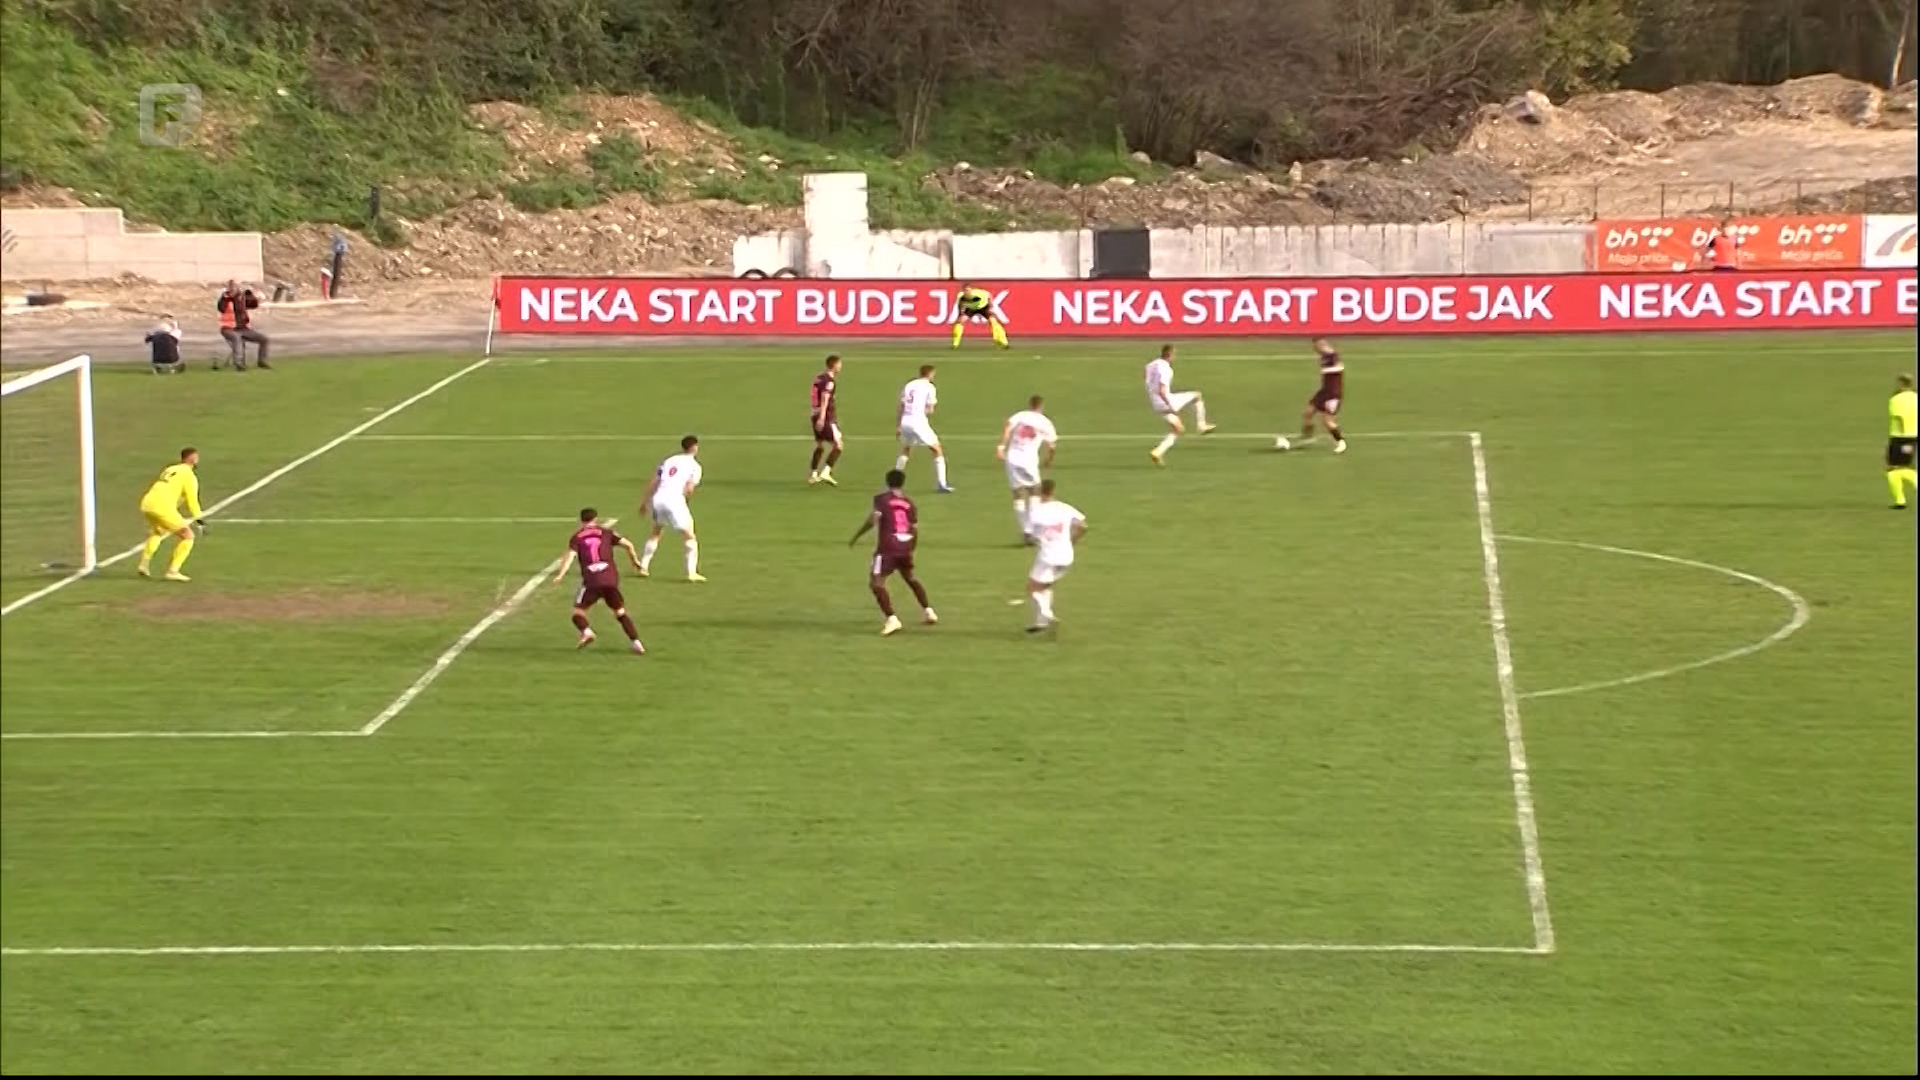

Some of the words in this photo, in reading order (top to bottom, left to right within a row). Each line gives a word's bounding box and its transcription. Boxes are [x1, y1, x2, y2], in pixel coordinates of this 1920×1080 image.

[521, 288, 639, 322] NEKA
[649, 288, 781, 323] START
[797, 289, 918, 324] BUDE
[1053, 290, 1171, 324] NEKA
[1182, 288, 1318, 324] START
[1333, 287, 1457, 322] BUDE
[1467, 285, 1553, 320] JAK
[1599, 283, 1725, 318] NEKA
[1736, 279, 1882, 317] START
